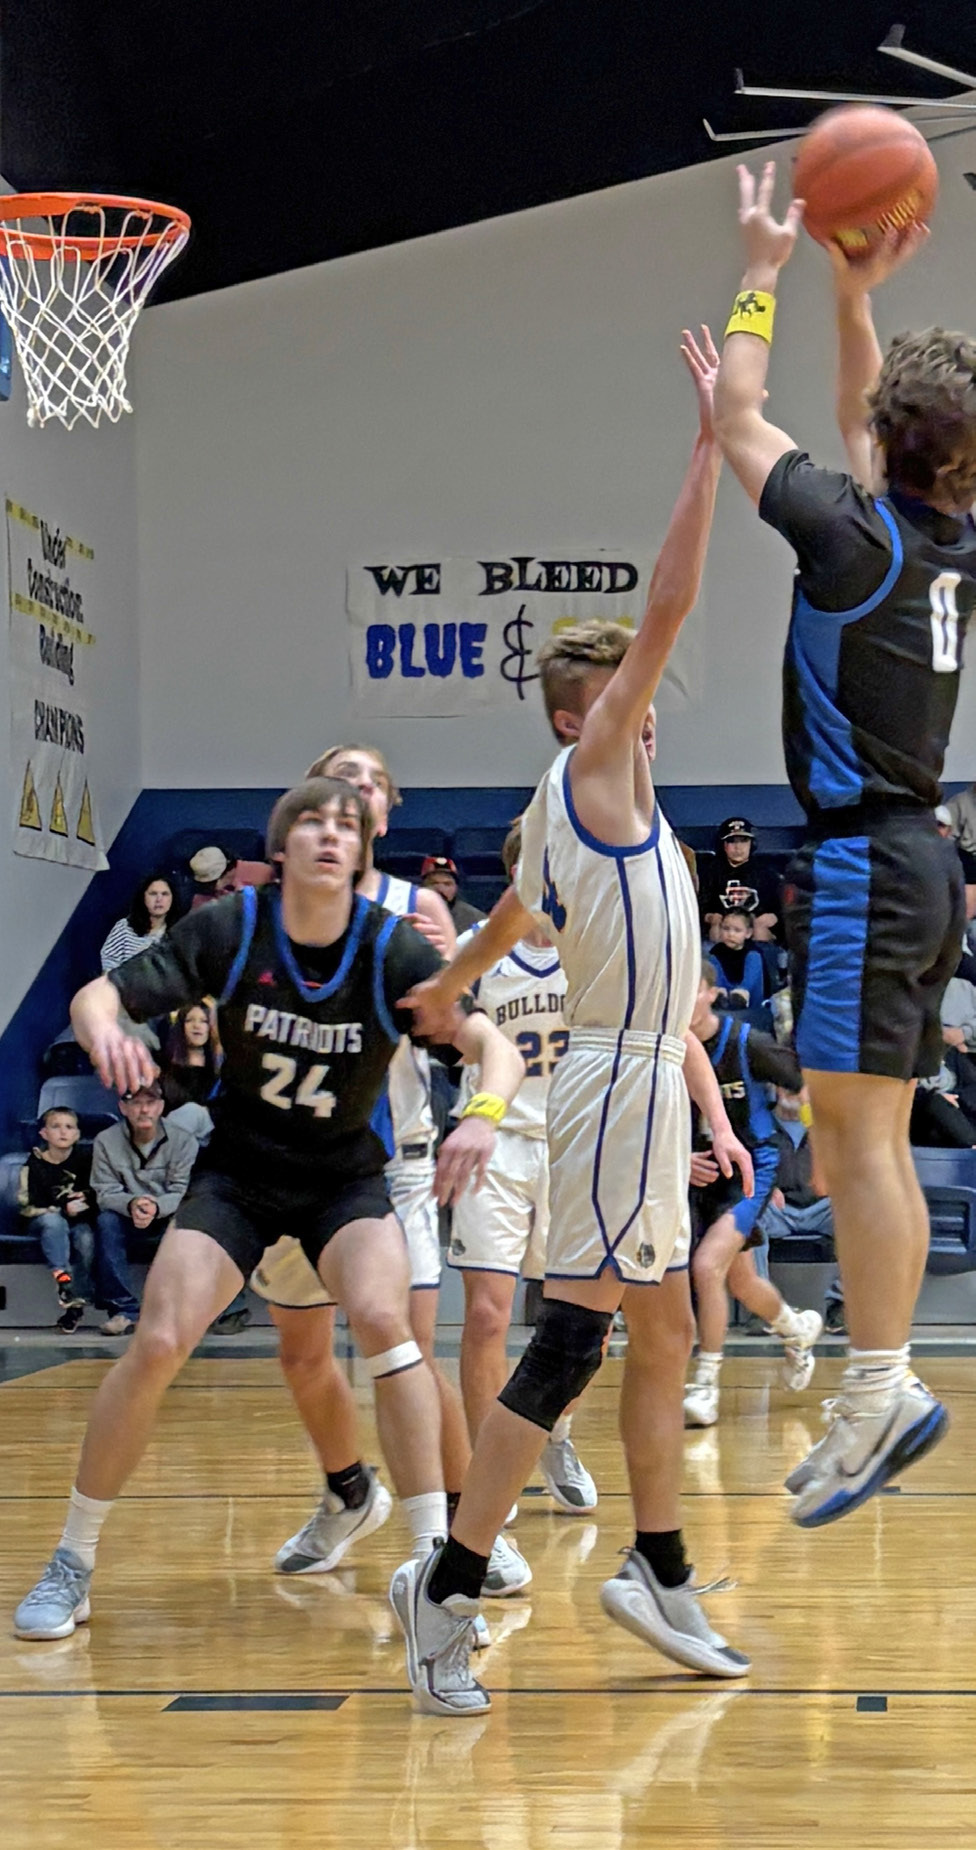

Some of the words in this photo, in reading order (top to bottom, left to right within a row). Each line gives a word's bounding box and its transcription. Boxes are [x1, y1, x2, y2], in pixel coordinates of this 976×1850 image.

[363, 562, 442, 598] WE
[477, 556, 639, 596] BLEED
[929, 571, 962, 673] 0
[366, 621, 488, 679] BLUE
[501, 604, 542, 701] &
[244, 1003, 364, 1054] PATRIOTS
[516, 1030, 570, 1077] 23
[260, 1053, 337, 1118] 24
